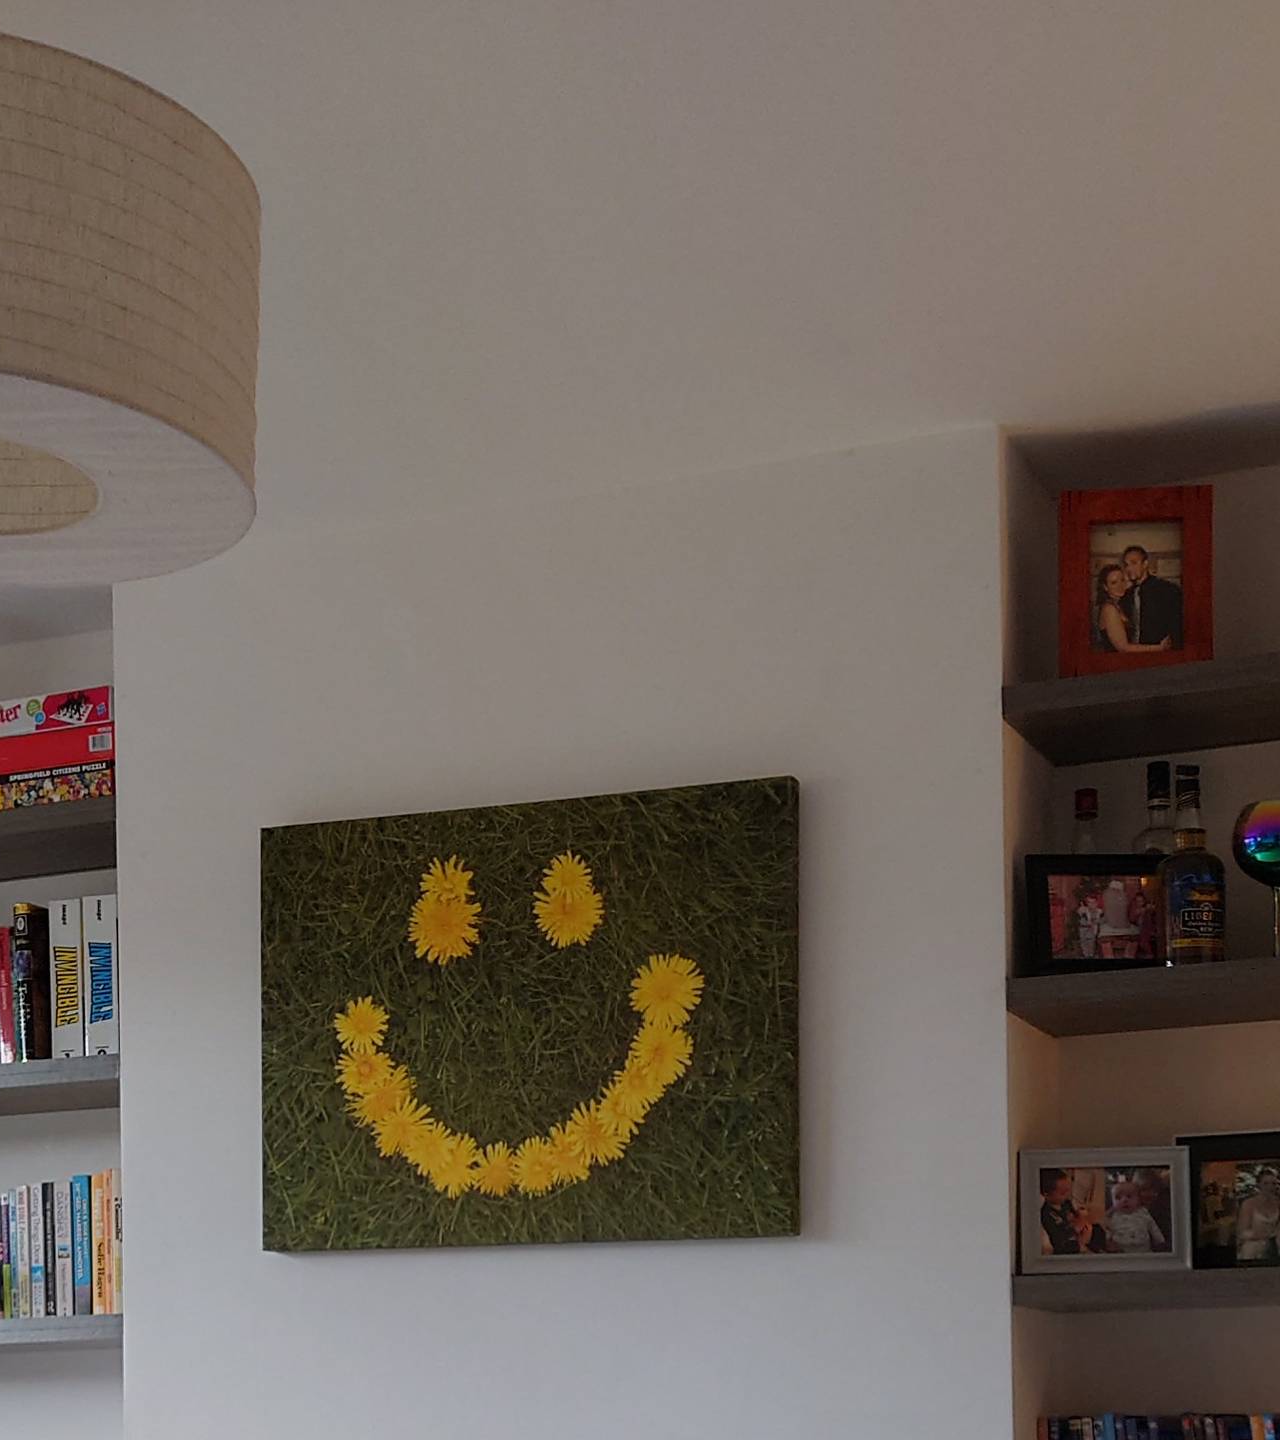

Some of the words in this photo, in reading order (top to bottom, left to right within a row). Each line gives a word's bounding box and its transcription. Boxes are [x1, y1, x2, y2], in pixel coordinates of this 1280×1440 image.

[9, 769, 51, 782] SPRINGFIELD
[52, 765, 81, 777] CITIZENS
[82, 762, 107, 772] PUZZLE
[54, 946, 80, 1028] INVINCIBLE
[89, 942, 113, 1024] INVINCIBLE
